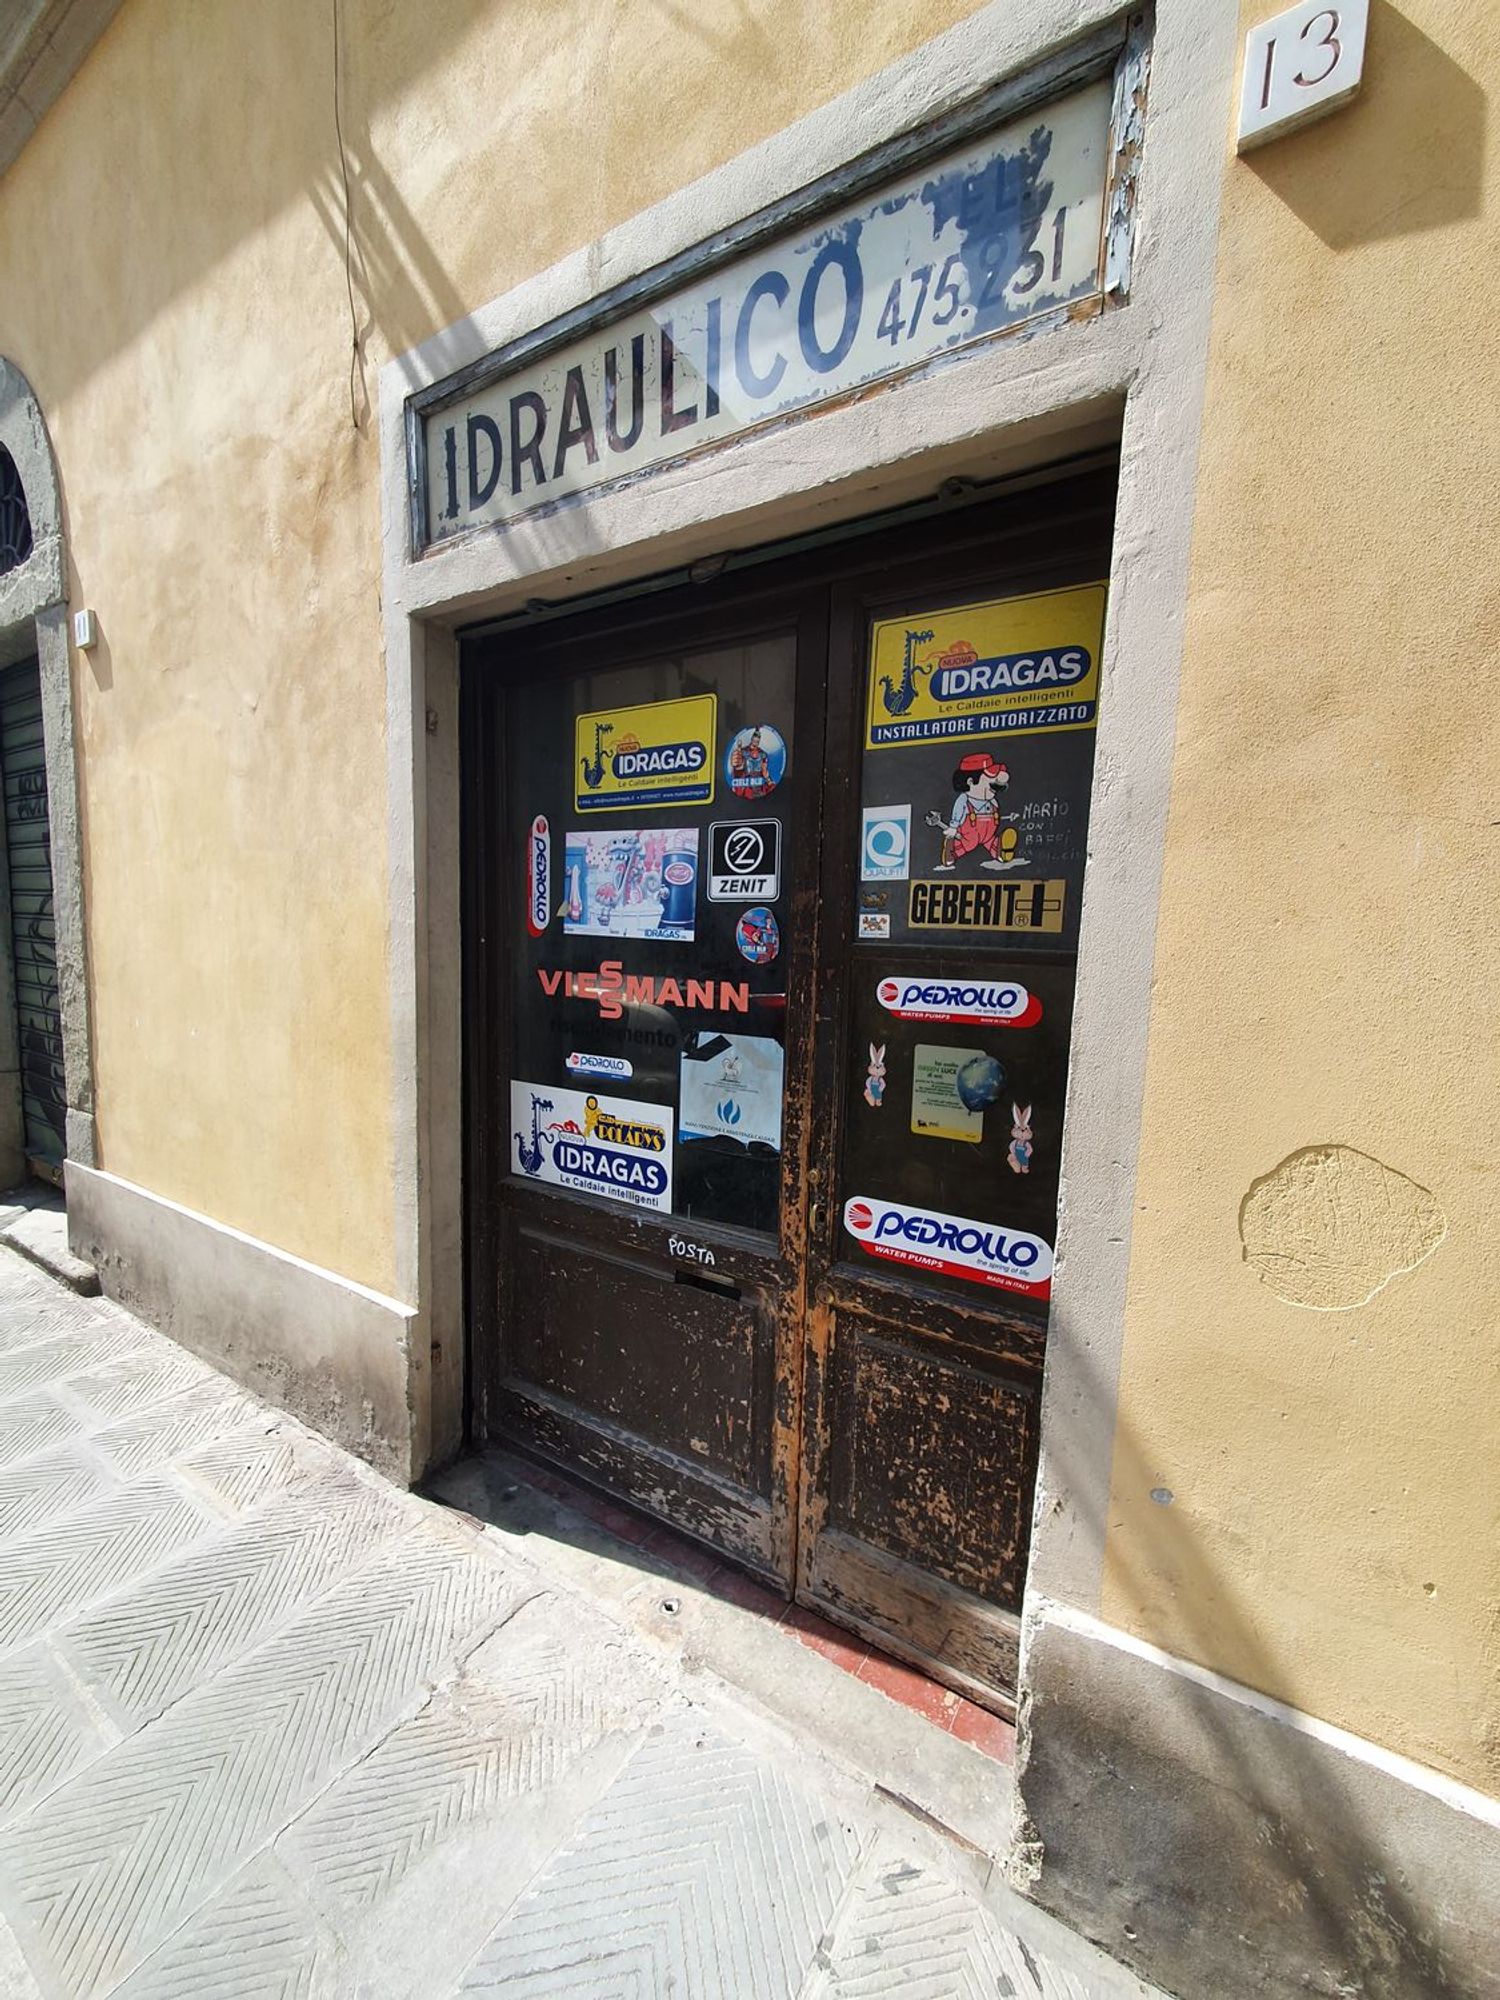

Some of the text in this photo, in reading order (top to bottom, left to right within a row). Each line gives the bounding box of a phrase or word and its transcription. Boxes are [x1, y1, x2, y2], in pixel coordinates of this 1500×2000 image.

[1259, 9, 1342, 110] 13
[444, 238, 863, 520] IDRAULICO
[941, 652, 1082, 696] IDRAGAS
[939, 688, 1074, 713] Le Caldaie intelligenti
[877, 705, 1088, 740] INSTALLATORE AUTORIZZATO
[618, 746, 702, 775] IDRAGAS
[533, 836, 547, 922] PEDROLLO
[719, 879, 768, 893] ZENIT
[911, 883, 1021, 926] GEBERIT
[644, 928, 681, 939] IDRAGAS
[537, 960, 750, 1020] VIESSMANN
[900, 984, 1018, 1009] PEDROLLO
[580, 1056, 624, 1070] PEDROLLO
[599, 1125, 662, 1151] POLARYS
[560, 1145, 660, 1189] IDRAGAS
[560, 1174, 659, 1207] Le Caldaie intelligenti
[668, 1238, 715, 1266] POSTA
[874, 1211, 1039, 1267] PEDROLLO
[874, 1245, 944, 1269] WATER PUMPS
[976, 1258, 988, 1266] the
[988, 1261, 1010, 1274] spring
[1019, 1267, 1030, 1277] life
[986, 1275, 1003, 1284] MADE
[1012, 1280, 1030, 1290] ITALY
